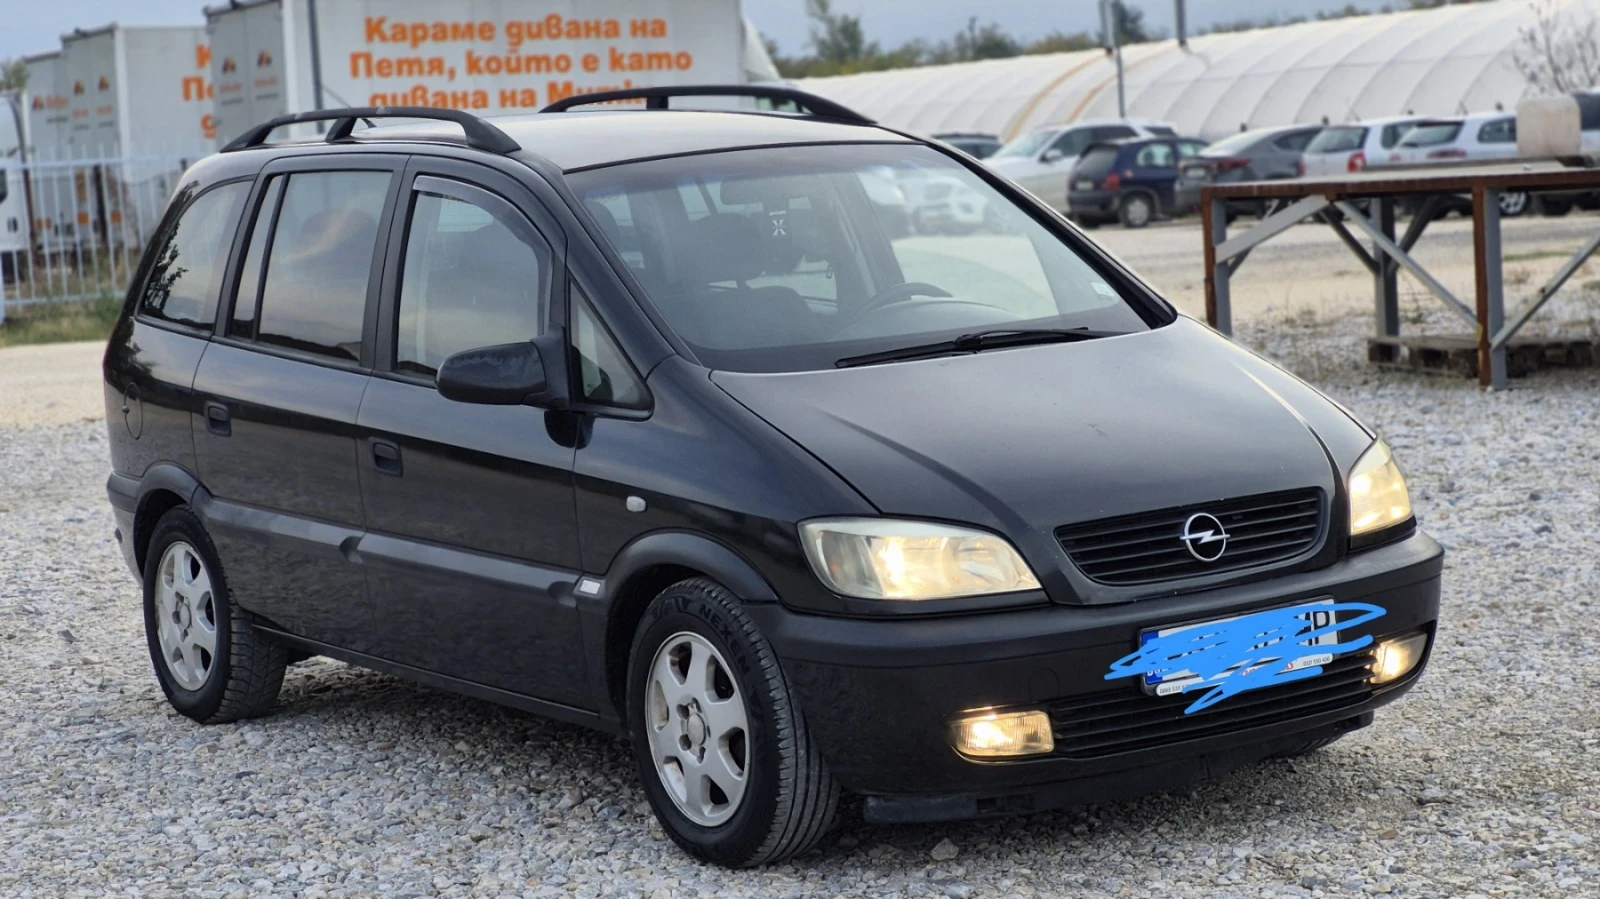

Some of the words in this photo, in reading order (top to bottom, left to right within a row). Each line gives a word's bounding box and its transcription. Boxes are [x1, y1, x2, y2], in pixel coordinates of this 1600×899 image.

[365, 17, 496, 49] Караме
[505, 14, 621, 47] дивана
[631, 19, 668, 39] на
[350, 52, 456, 81] Петя,
[466, 49, 573, 77] който
[582, 53, 600, 73] е
[610, 47, 693, 72] като
[499, 88, 537, 109] на
